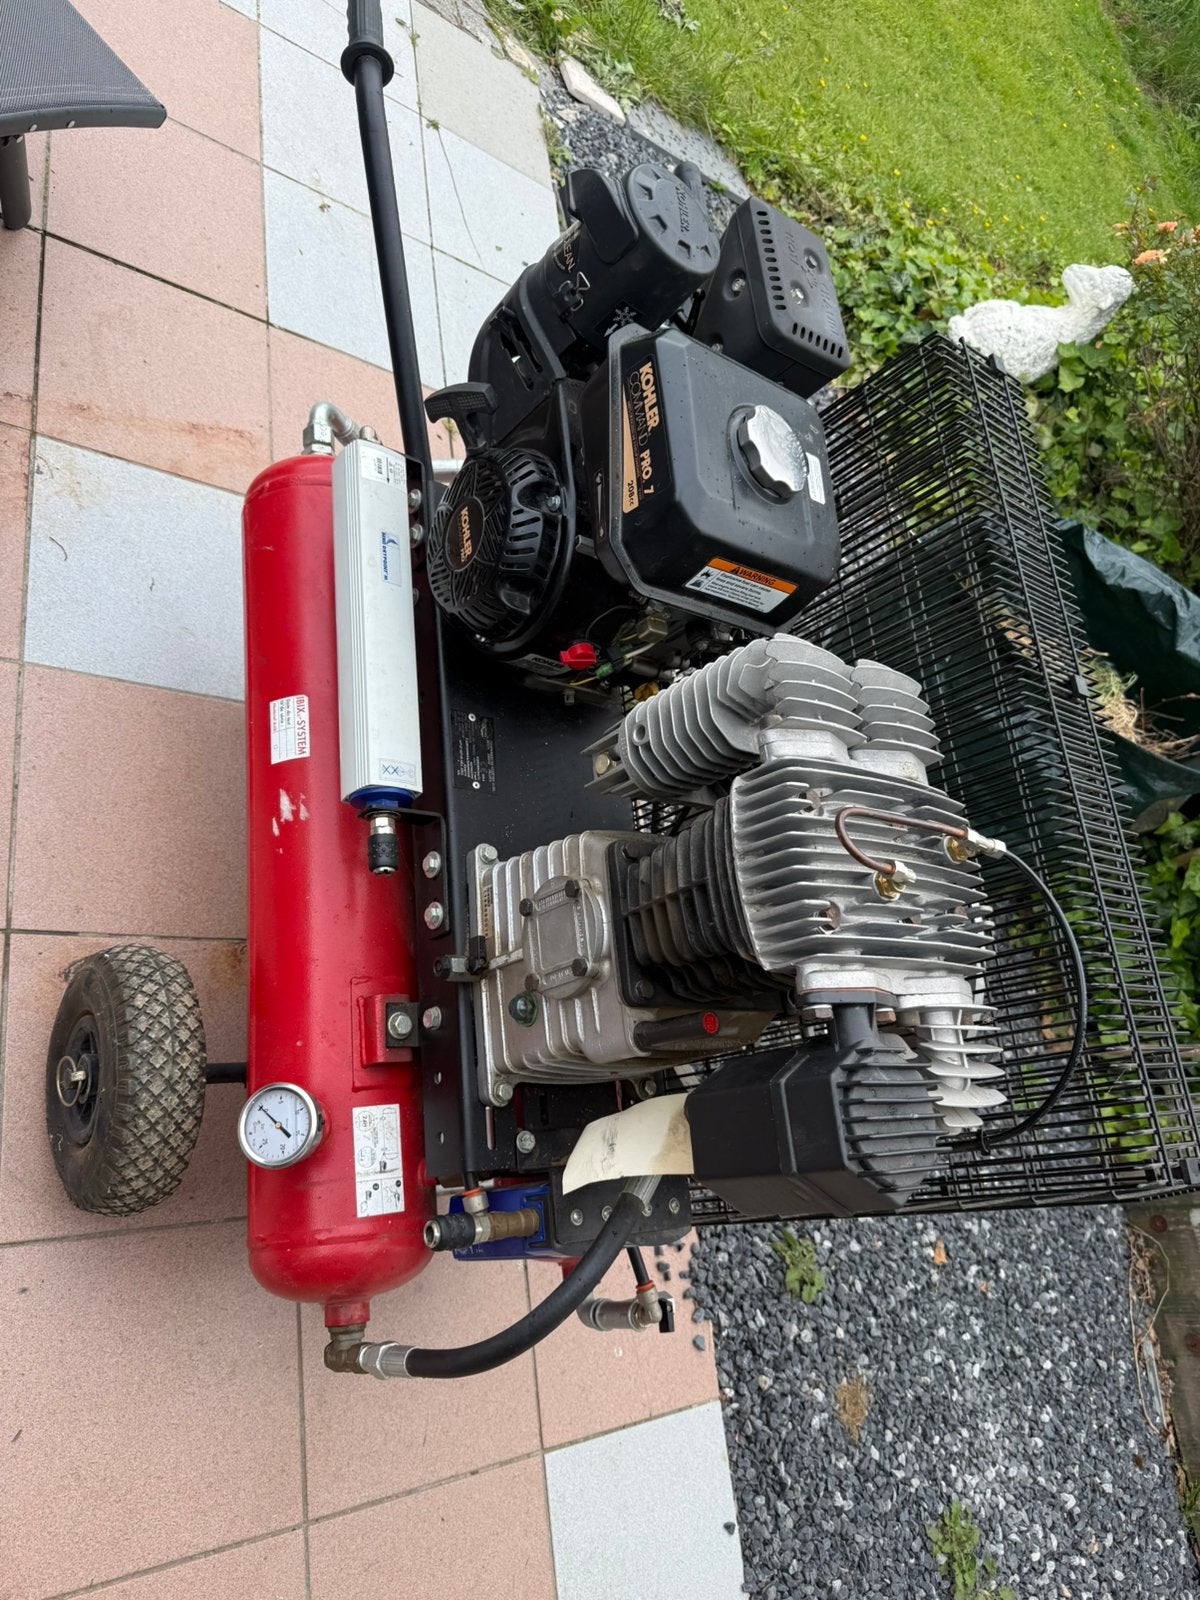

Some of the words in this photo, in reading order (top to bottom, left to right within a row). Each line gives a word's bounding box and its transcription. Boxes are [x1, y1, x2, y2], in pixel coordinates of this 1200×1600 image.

[630, 371, 648, 446] COMMAND
[644, 485, 654, 494] 7
[627, 480, 635, 506] 208cc
[461, 507, 472, 557] KOHLER
[739, 569, 777, 586] WARNING
